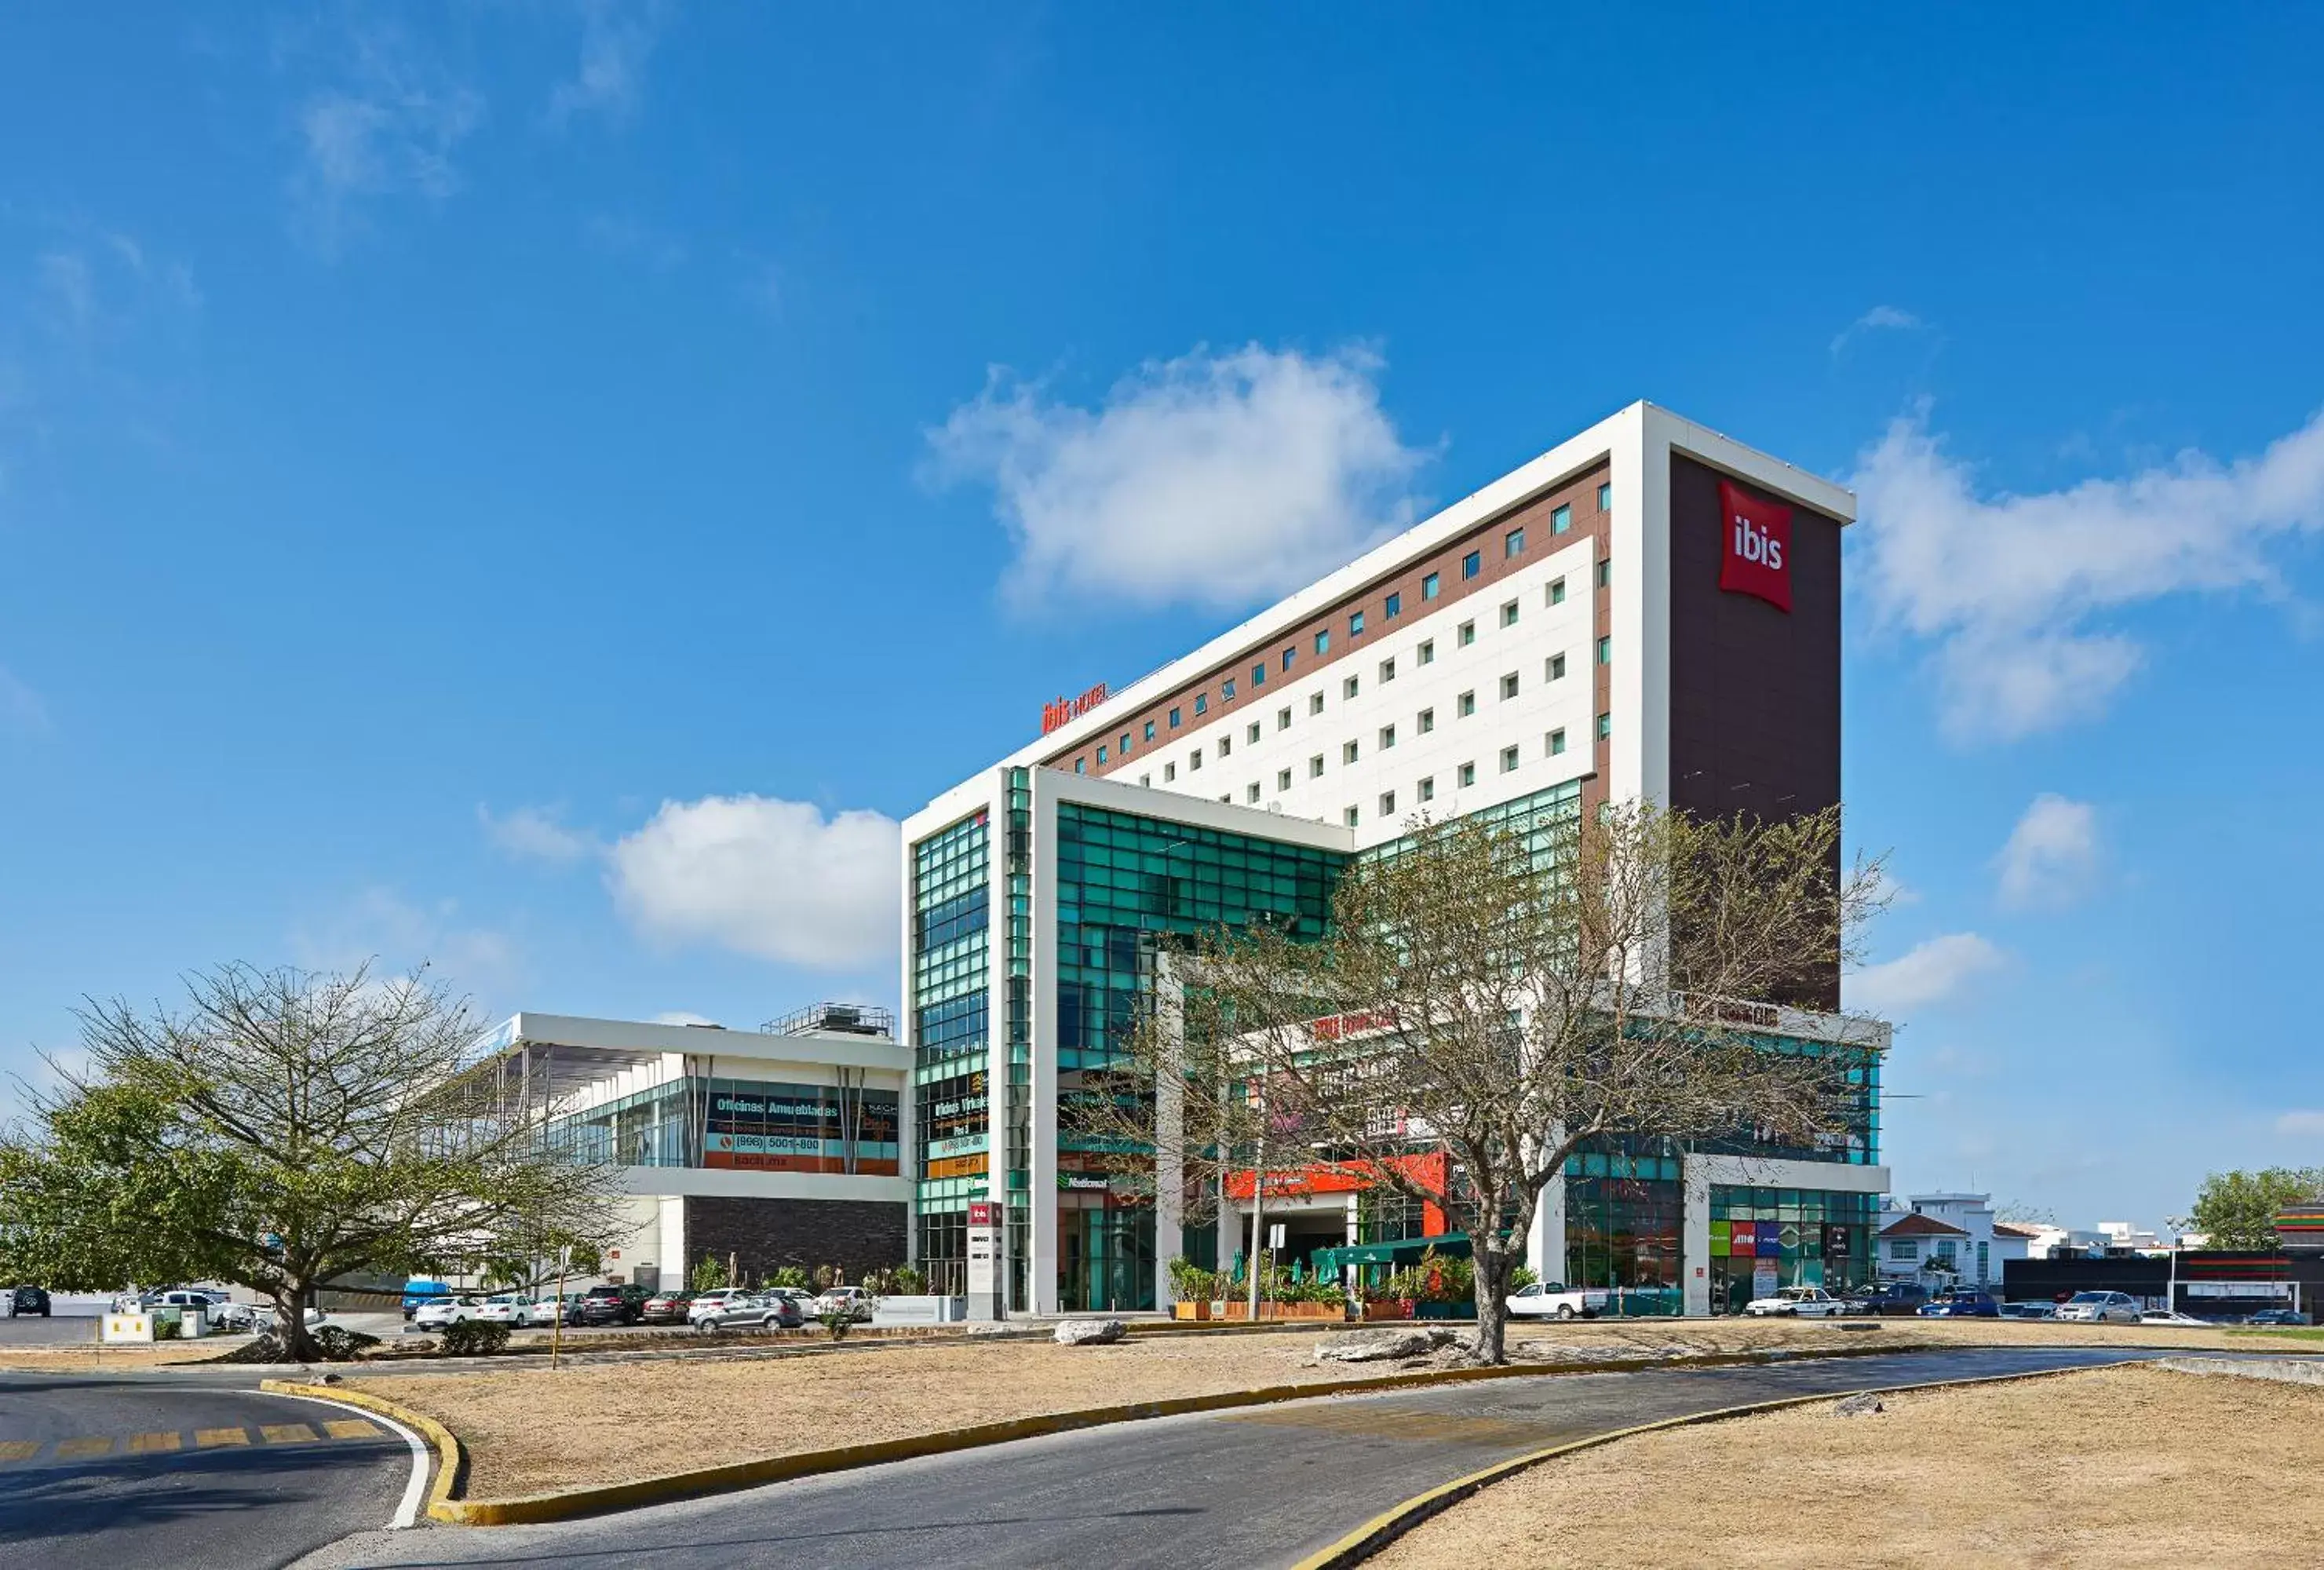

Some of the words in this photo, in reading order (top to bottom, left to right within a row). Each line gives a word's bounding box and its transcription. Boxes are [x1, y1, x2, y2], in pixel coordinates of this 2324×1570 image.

[1735, 515, 1782, 570] ibis
[1042, 696, 1070, 735] ibis
[717, 1099, 764, 1113] Oficinas
[1068, 1178, 1107, 1188] National
